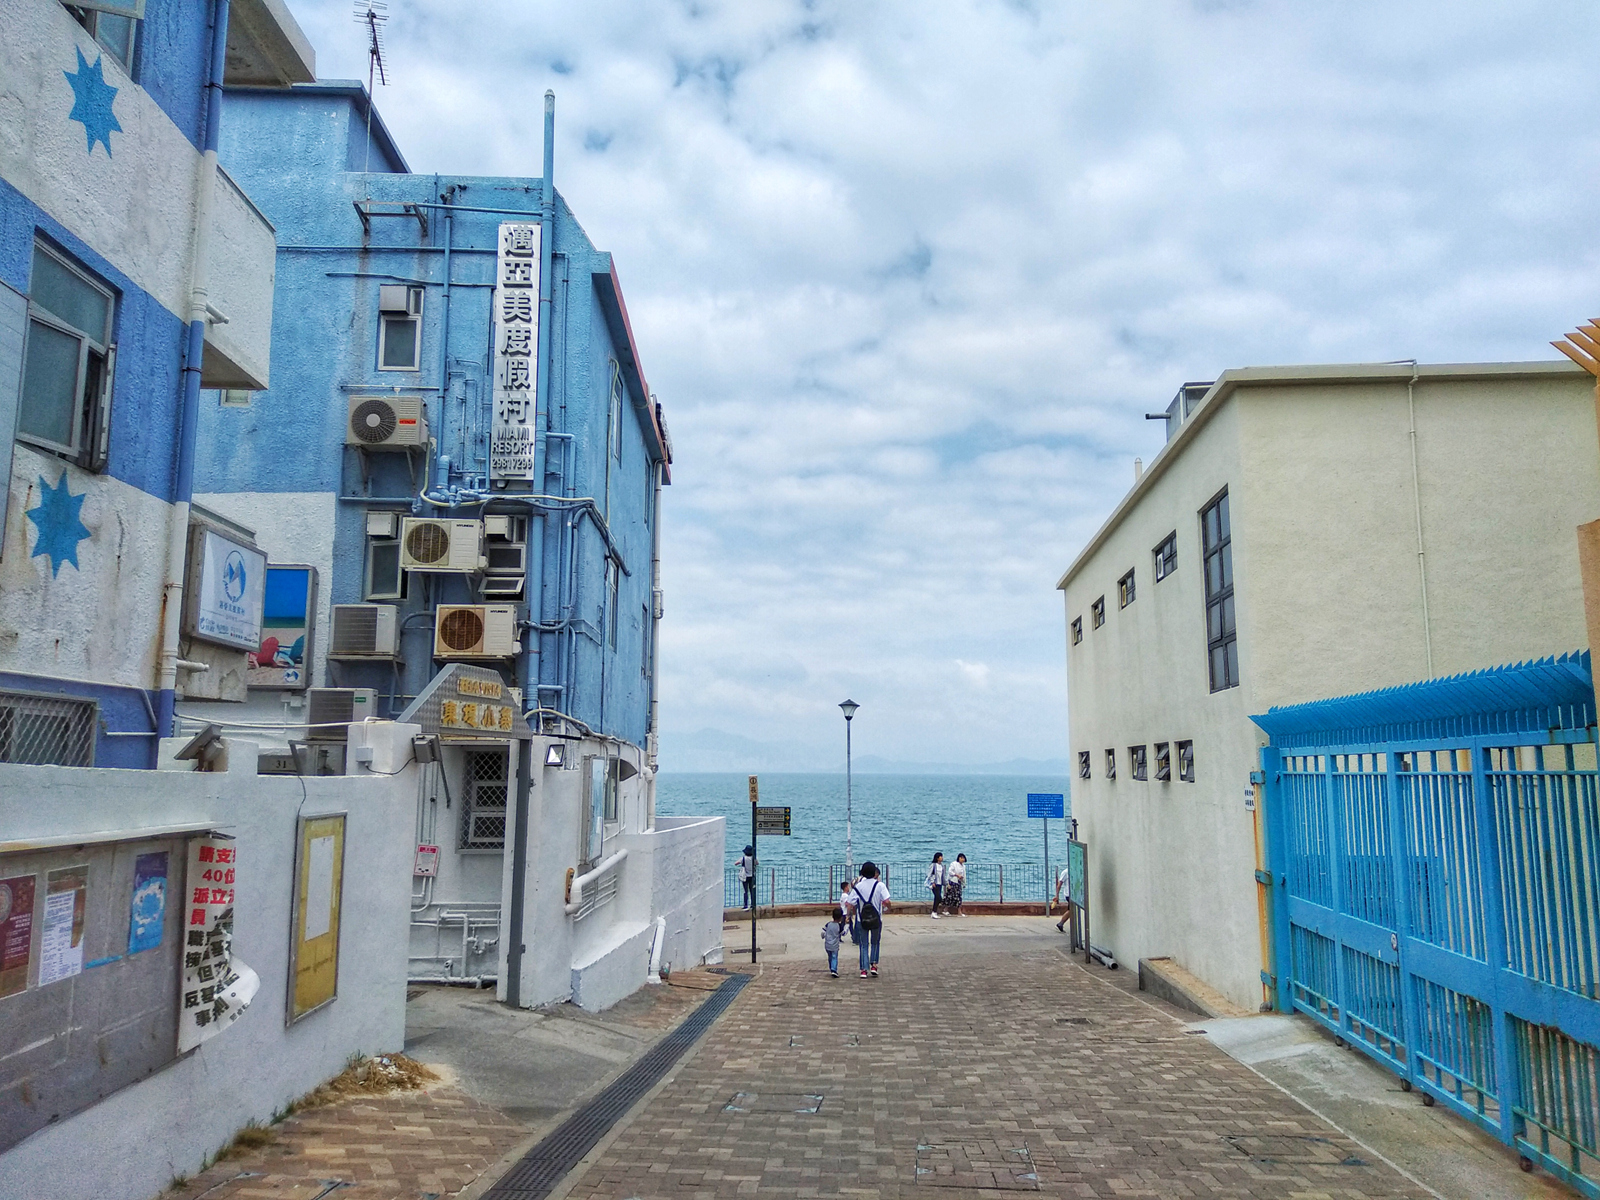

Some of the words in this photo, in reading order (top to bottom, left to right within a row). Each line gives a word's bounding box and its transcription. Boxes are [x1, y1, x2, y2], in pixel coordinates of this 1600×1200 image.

[499, 226, 533, 425] 邁亞美度假村
[497, 427, 529, 441] MIAMI
[492, 441, 534, 455] RESORT
[275, 760, 286, 768] 31
[199, 846, 236, 863] 請支
